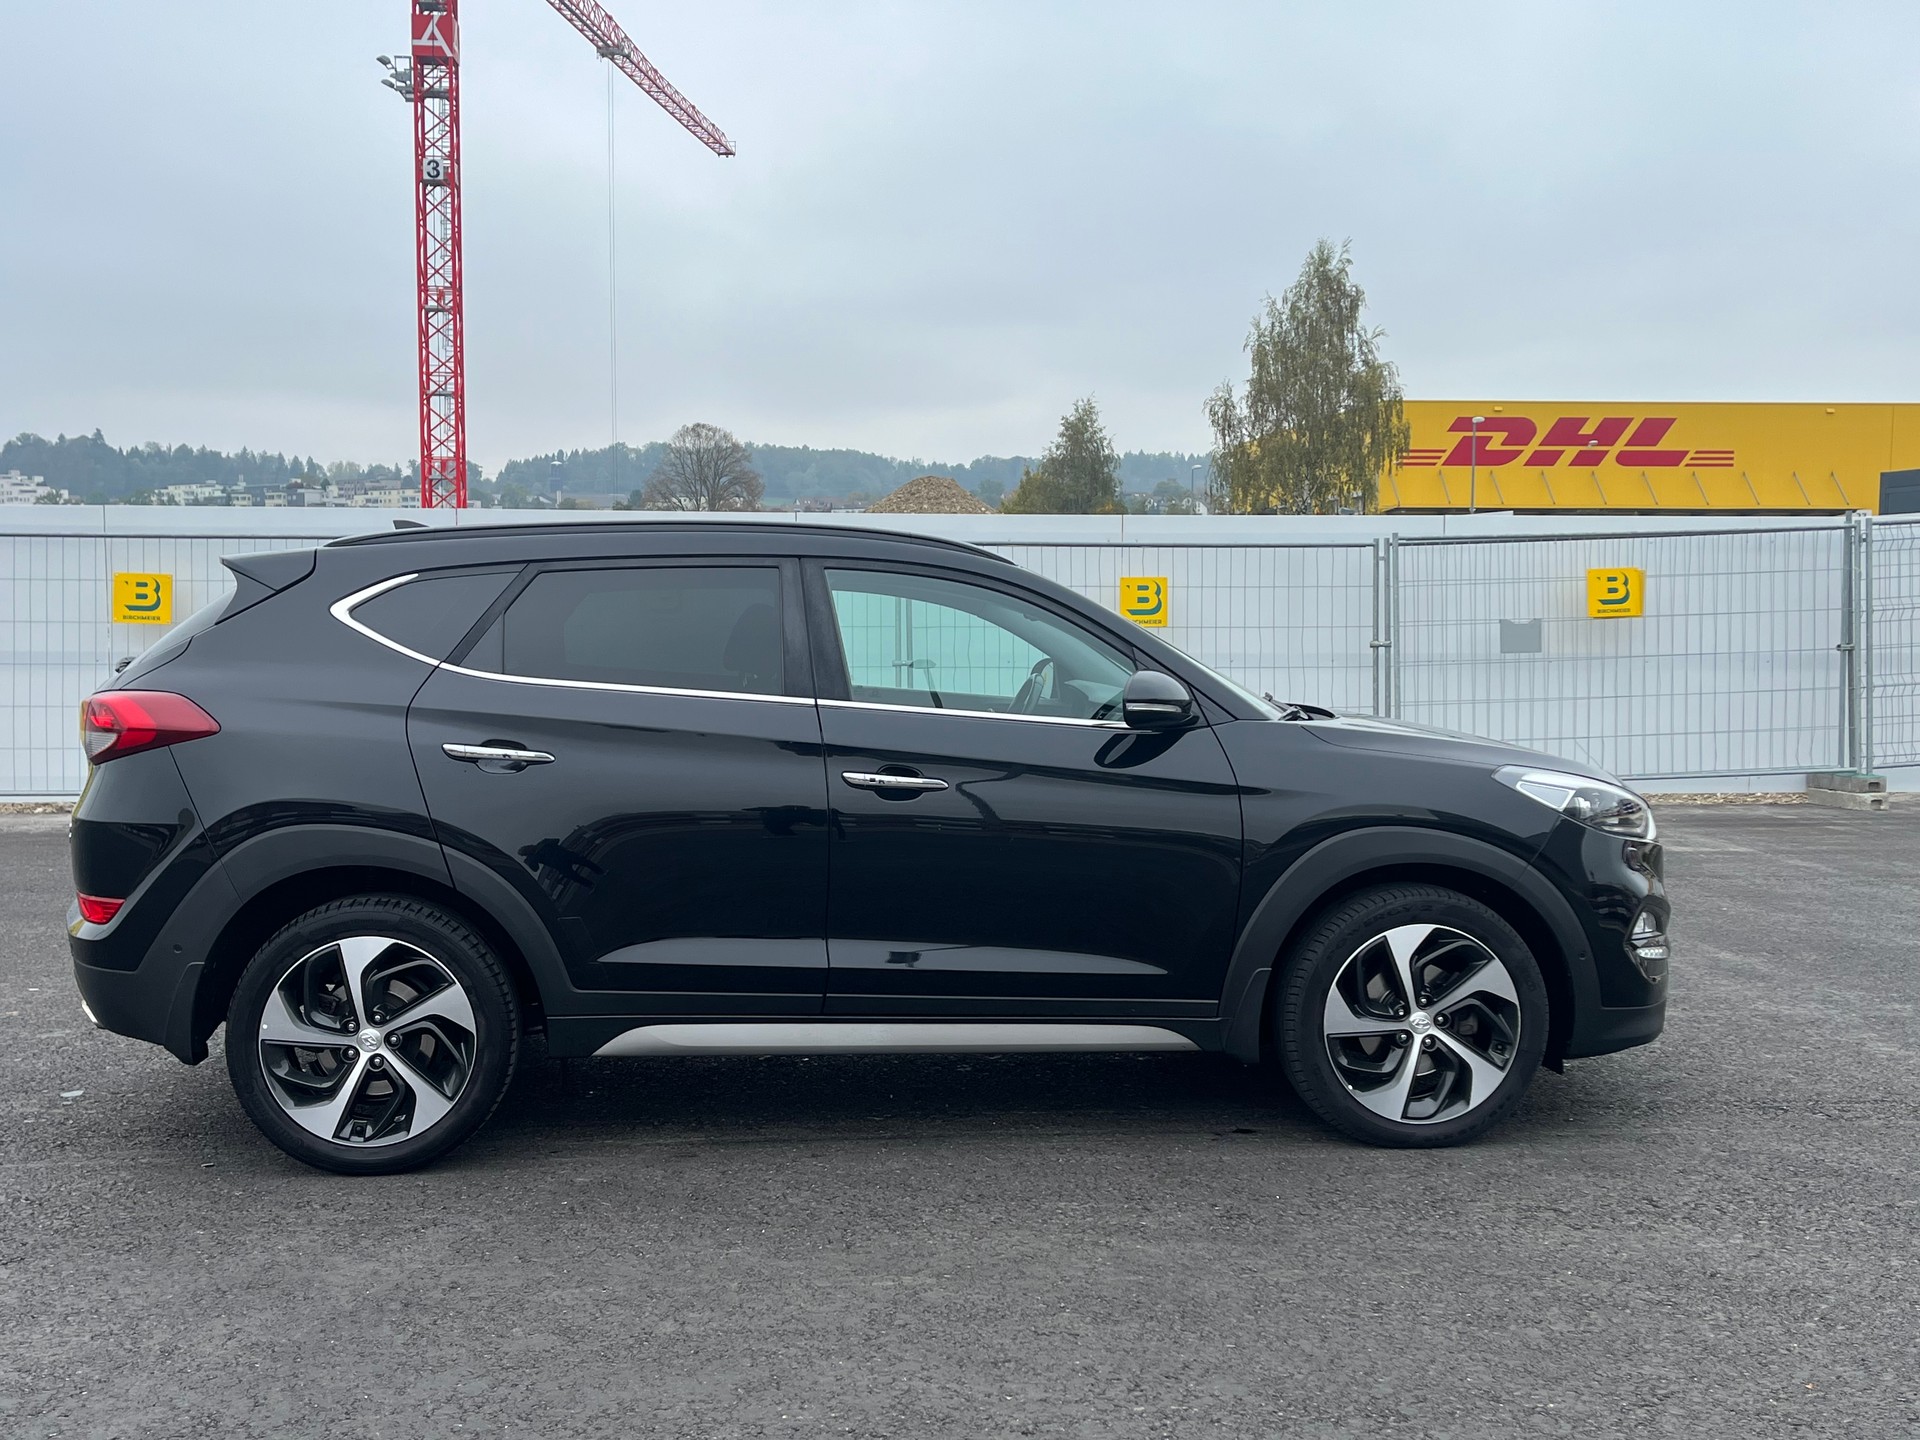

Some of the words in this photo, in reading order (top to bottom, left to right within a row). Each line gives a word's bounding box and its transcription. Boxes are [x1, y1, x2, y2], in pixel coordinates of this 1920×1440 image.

[426, 160, 441, 179] 3
[1441, 417, 1690, 467] DHL
[124, 576, 160, 611] B
[1126, 580, 1162, 615] B
[1596, 571, 1630, 605] B
